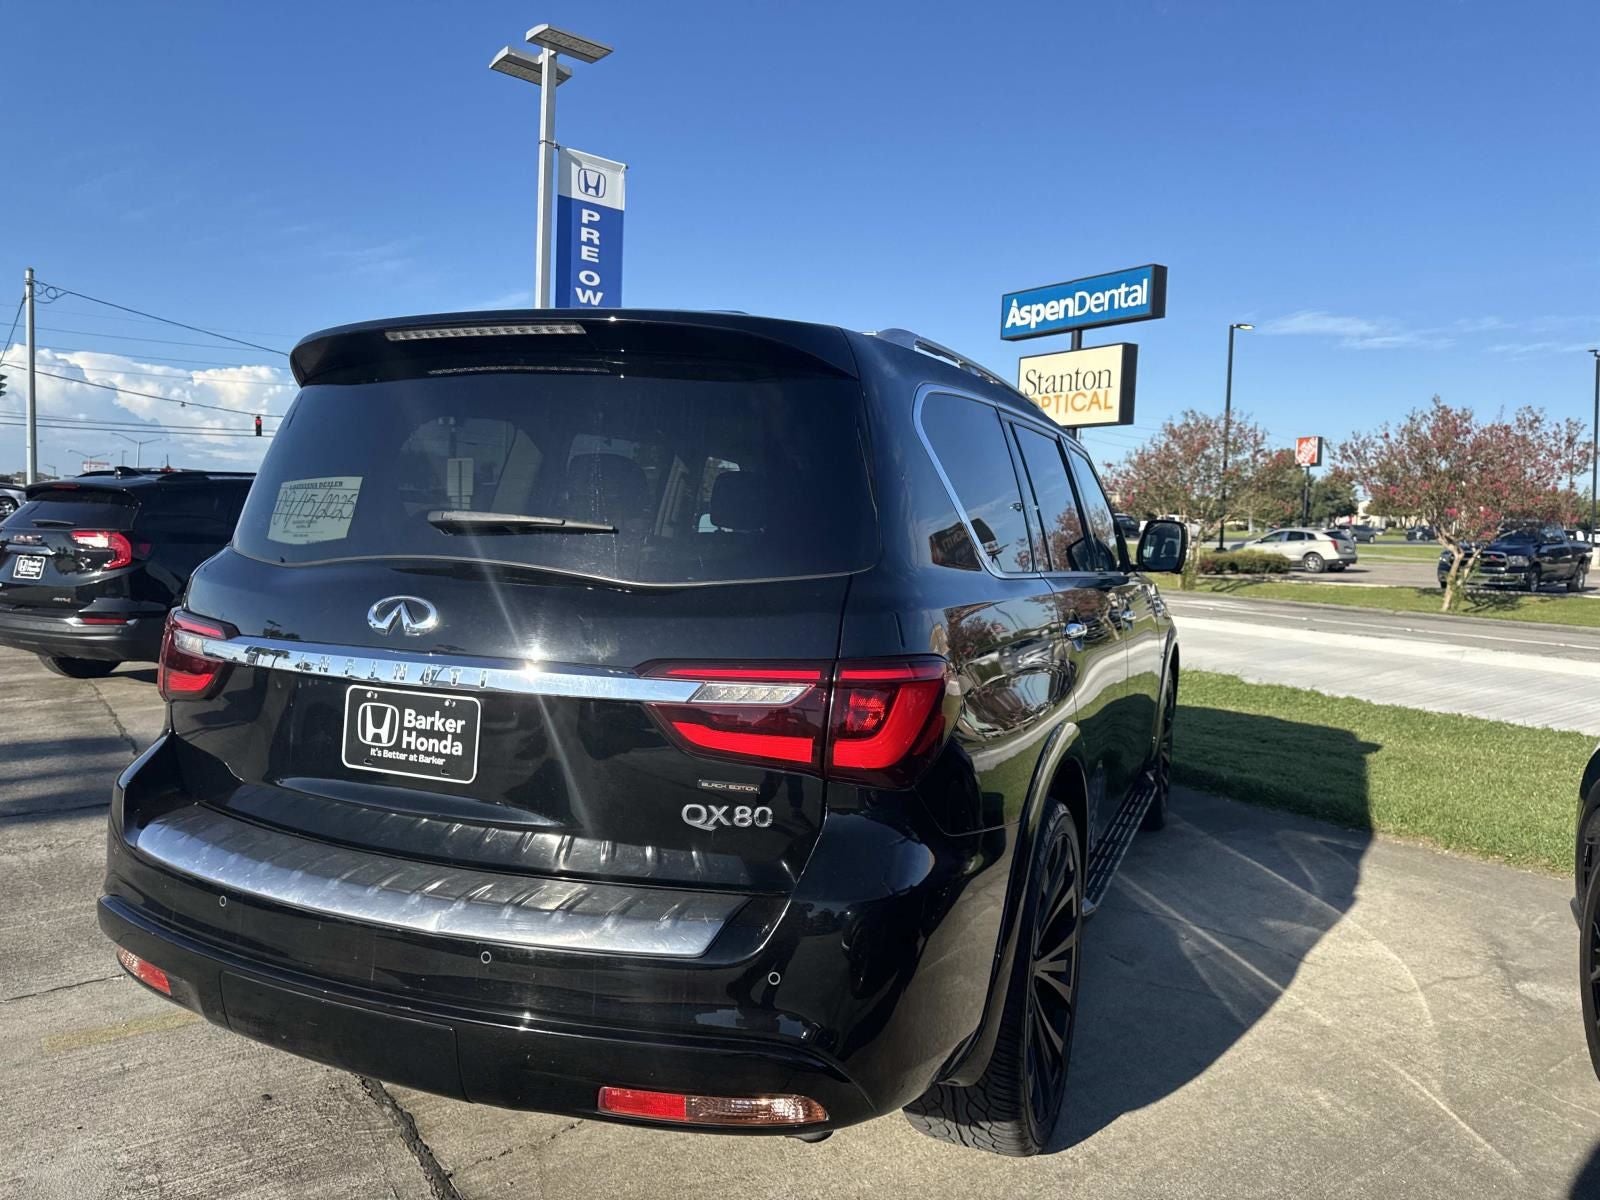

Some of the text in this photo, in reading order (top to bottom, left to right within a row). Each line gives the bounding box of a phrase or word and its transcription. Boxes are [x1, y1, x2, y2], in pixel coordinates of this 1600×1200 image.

[575, 208, 603, 307] PRE OW
[1005, 278, 1148, 328] AspenDental
[1024, 367, 1113, 396] Stanton
[403, 708, 466, 734] Barker
[401, 729, 463, 756] Honda
[382, 749, 408, 761] Better
[408, 753, 418, 762] at
[418, 754, 446, 765] Barker
[728, 784, 758, 792] EDITION
[681, 803, 774, 832] QX80
